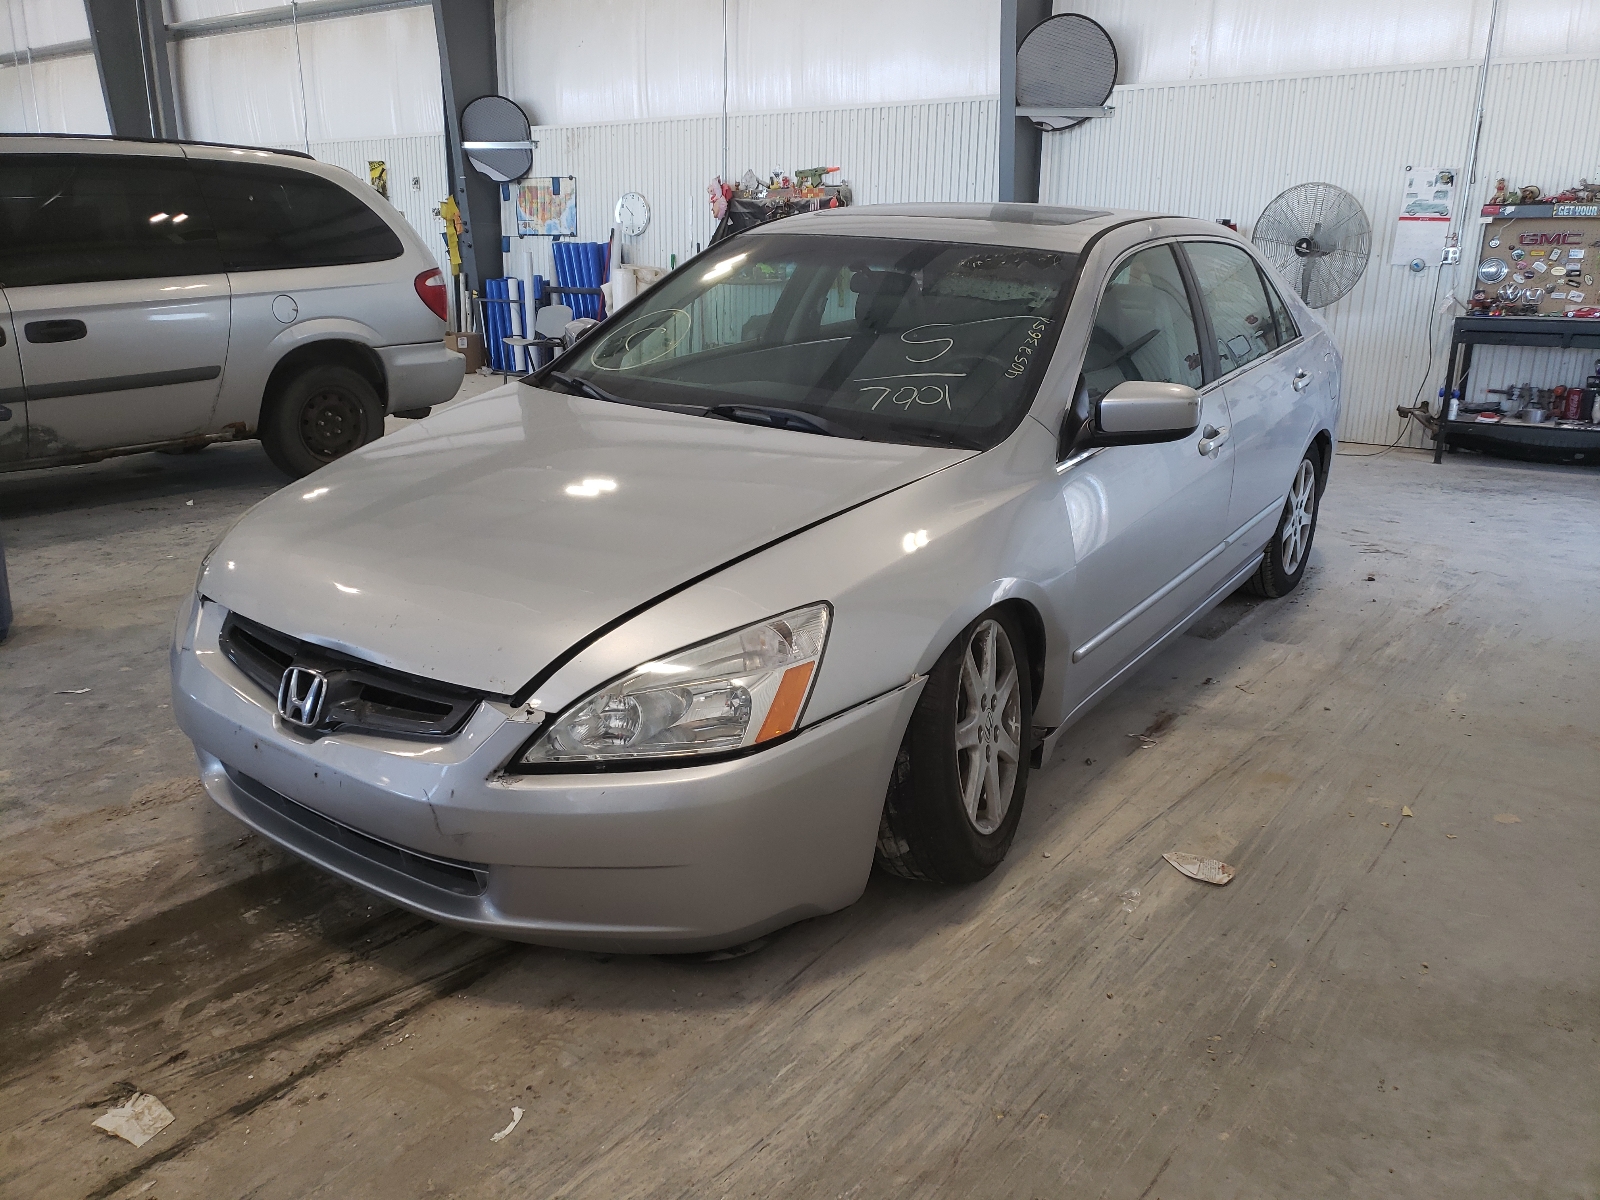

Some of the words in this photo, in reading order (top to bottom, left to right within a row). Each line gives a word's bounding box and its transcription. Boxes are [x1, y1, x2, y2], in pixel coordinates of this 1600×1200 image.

[1558, 205, 1574, 216] GET
[1575, 205, 1598, 216] YOUR
[1519, 232, 1584, 246] GMC
[859, 383, 952, 411] 7901
